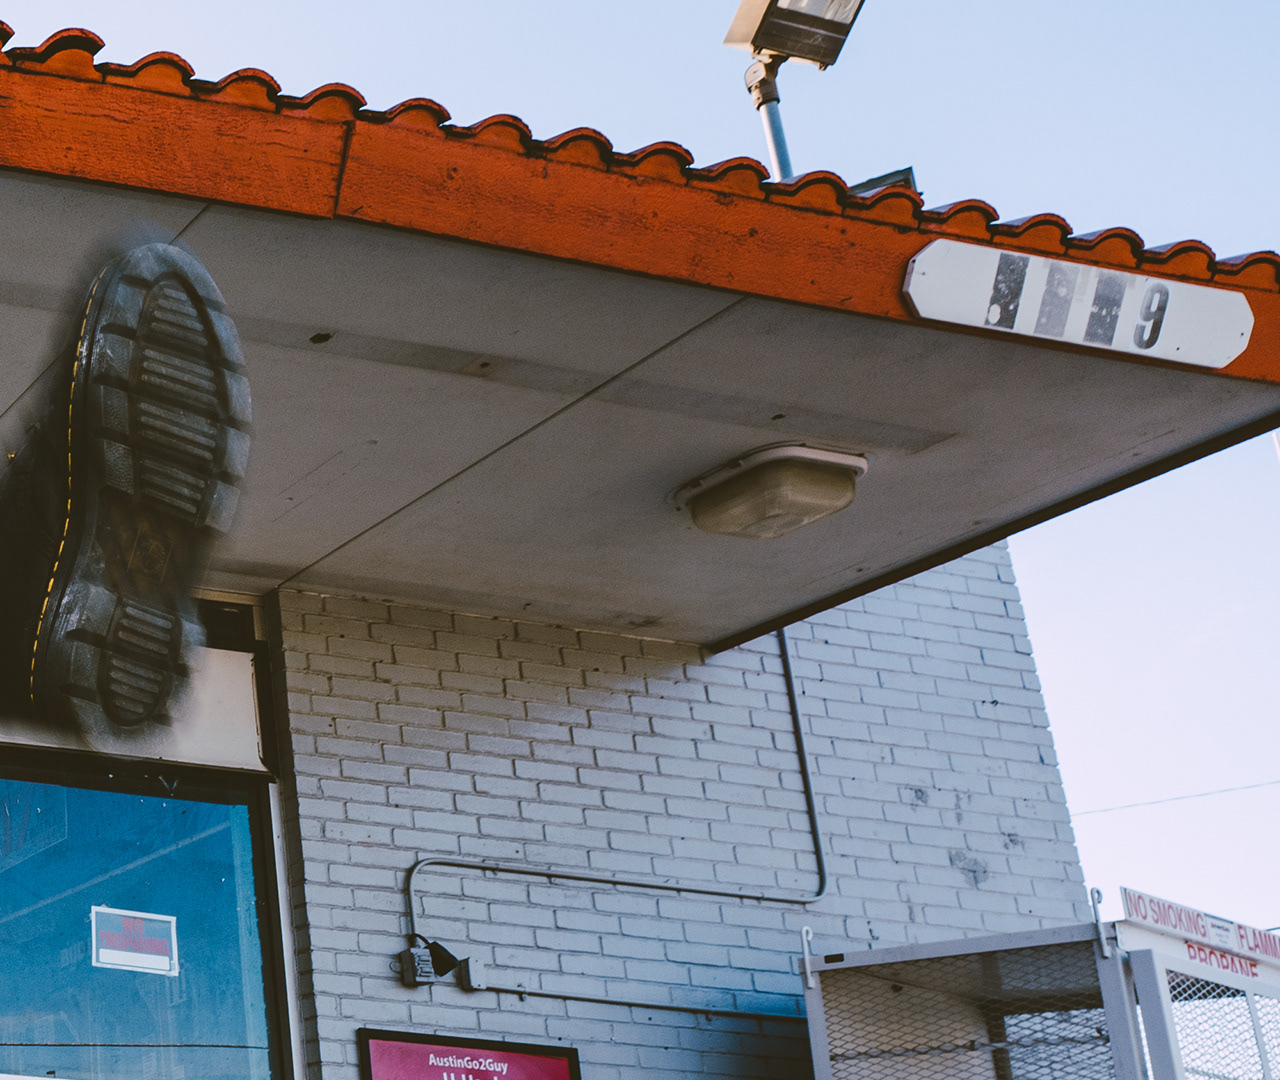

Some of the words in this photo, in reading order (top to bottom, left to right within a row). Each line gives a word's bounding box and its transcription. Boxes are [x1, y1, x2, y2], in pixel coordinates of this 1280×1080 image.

[122, 916, 145, 935] NO
[1127, 891, 1148, 921] NO
[1149, 897, 1207, 938] SMOKING
[99, 931, 170, 956] TRESPASSING
[428, 1053, 508, 1075] AustinGo2Guy
